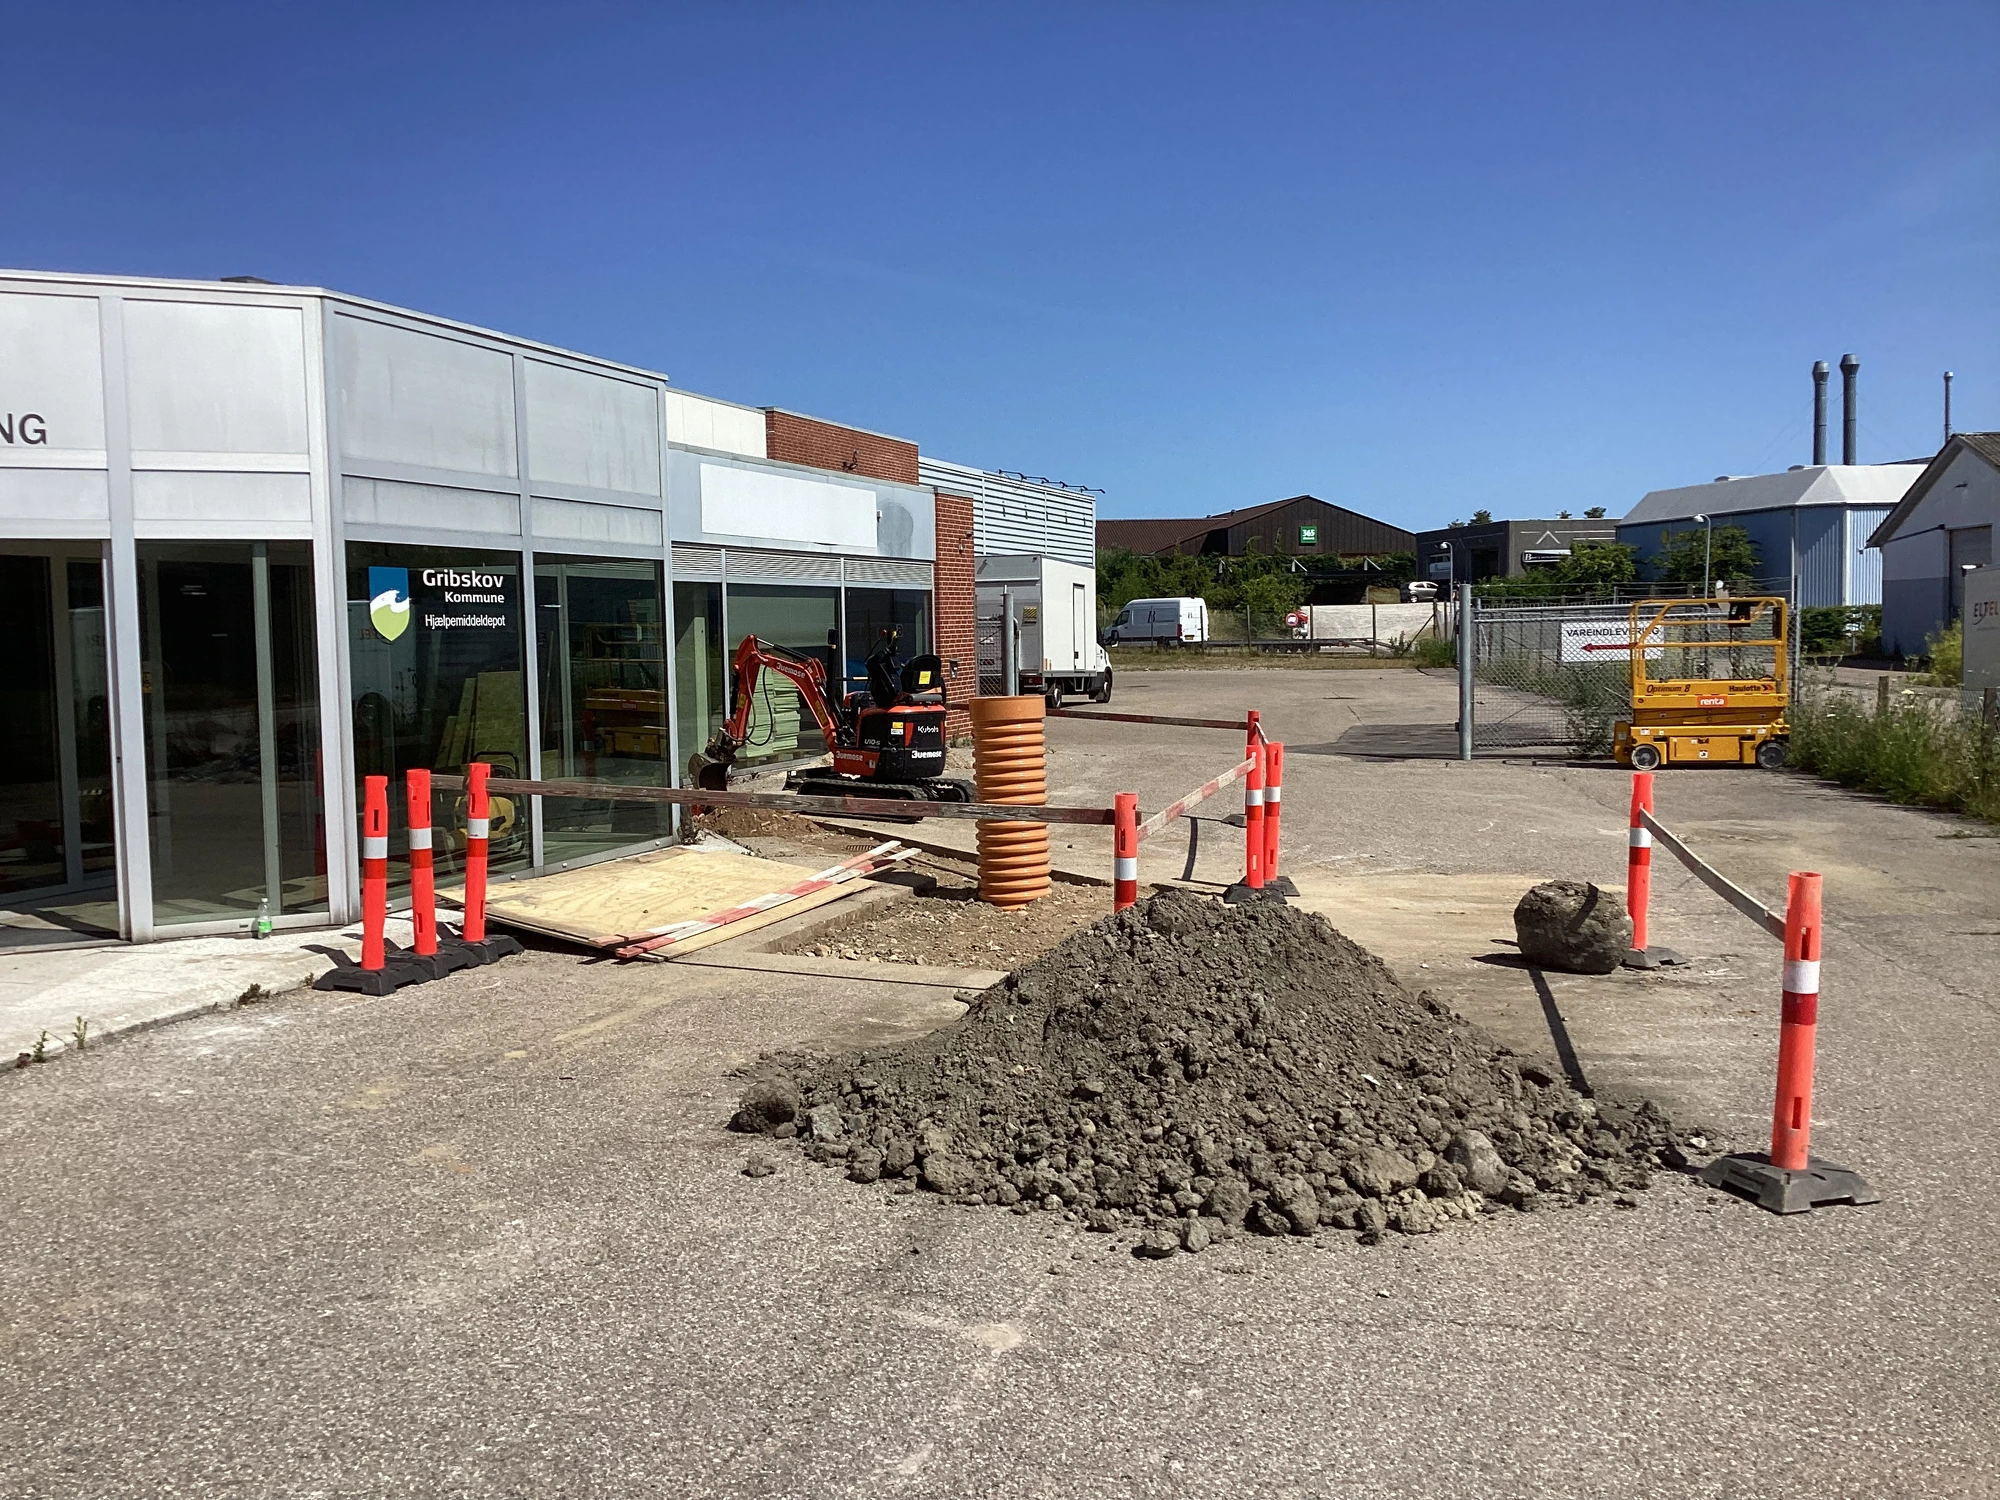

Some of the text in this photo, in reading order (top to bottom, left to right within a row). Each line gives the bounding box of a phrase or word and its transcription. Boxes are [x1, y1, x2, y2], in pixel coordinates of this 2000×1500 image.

[1302, 529, 1316, 537] 365
[422, 569, 504, 588] Gribskov
[444, 591, 505, 604] Kommune
[425, 614, 506, 629] Hjælpemiddeldepot
[1566, 626, 1661, 637] VAREINDLEVRIG
[1646, 684, 1691, 695] Optimum 8
[1729, 684, 1762, 692] Haulotte
[1700, 697, 1725, 706] renta
